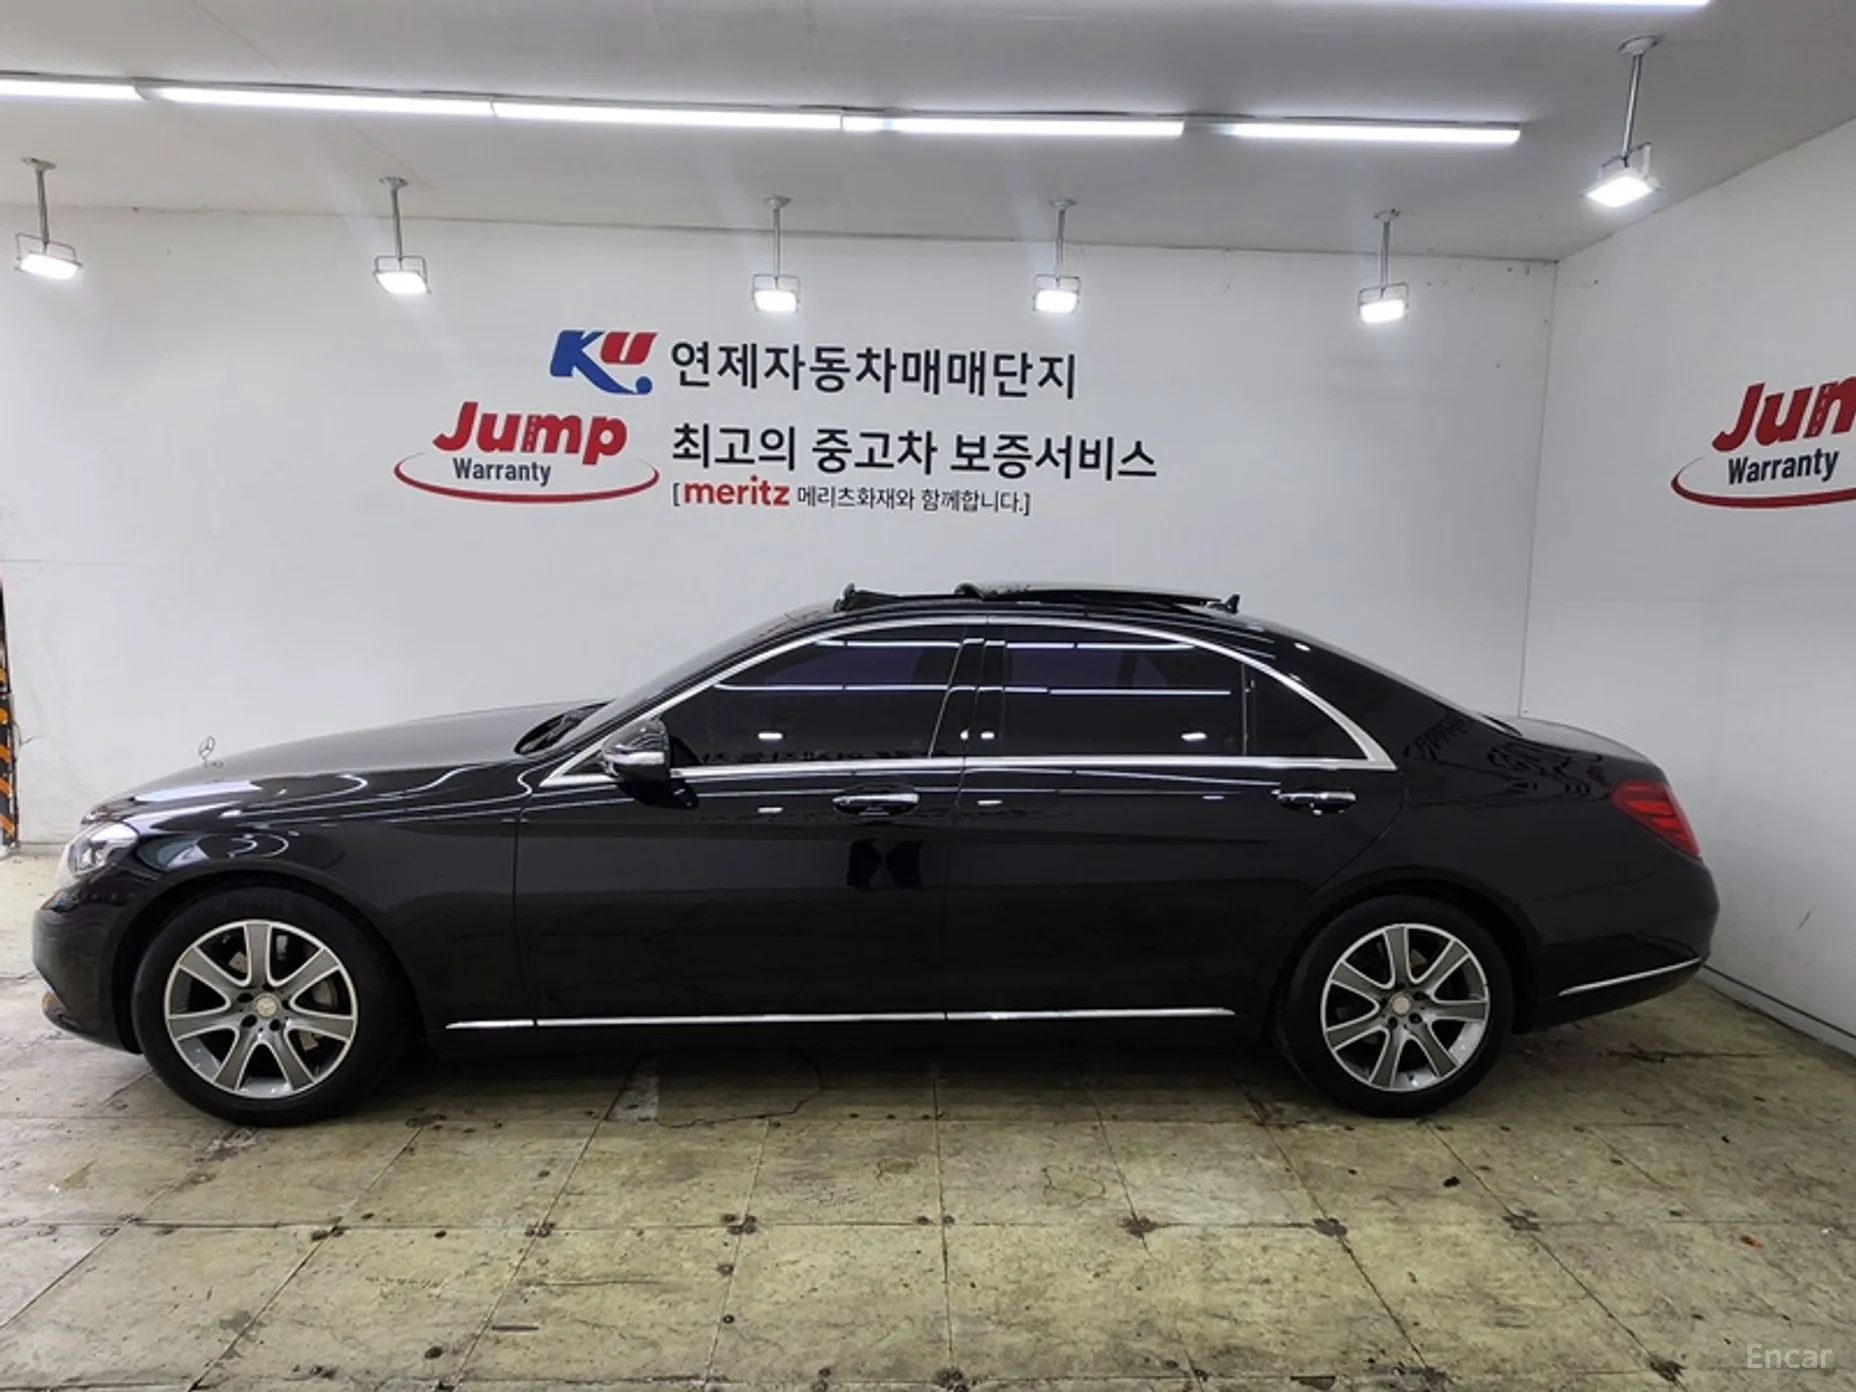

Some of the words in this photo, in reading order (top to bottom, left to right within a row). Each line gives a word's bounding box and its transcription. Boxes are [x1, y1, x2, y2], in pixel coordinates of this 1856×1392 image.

[670, 340, 1077, 400] 연제자동차매매단지
[432, 401, 628, 465] Jump
[671, 423, 797, 471] 최고의
[811, 428, 939, 476] 중고차
[949, 433, 1159, 482] 보증서비스
[452, 456, 552, 488] Warranty
[1727, 447, 1840, 486] Warranty
[797, 485, 916, 510] 메리츠화재와
[921, 488, 1031, 517] 함께합니다.]
